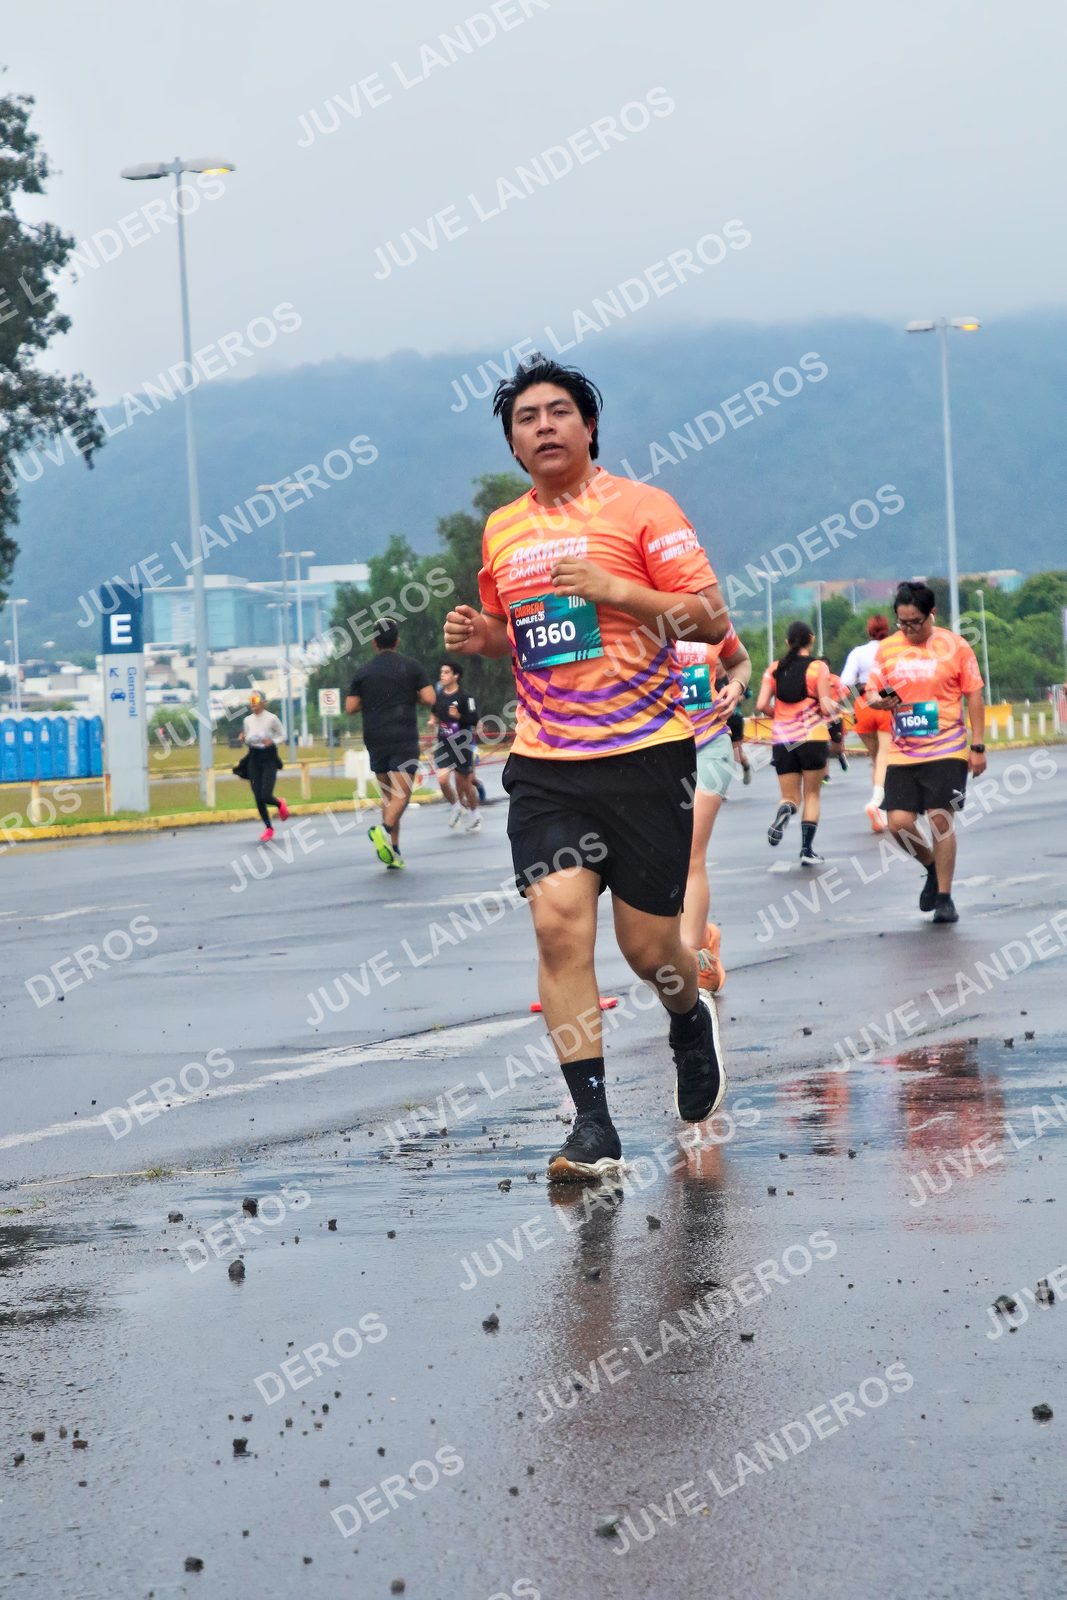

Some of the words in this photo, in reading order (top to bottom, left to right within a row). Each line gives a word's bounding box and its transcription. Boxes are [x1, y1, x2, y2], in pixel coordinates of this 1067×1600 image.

[515, 602, 544, 618] CARRERA
[110, 613, 133, 646] E
[525, 620, 576, 649] 1360
[127, 666, 138, 718] General
[901, 715, 929, 728] 1604
